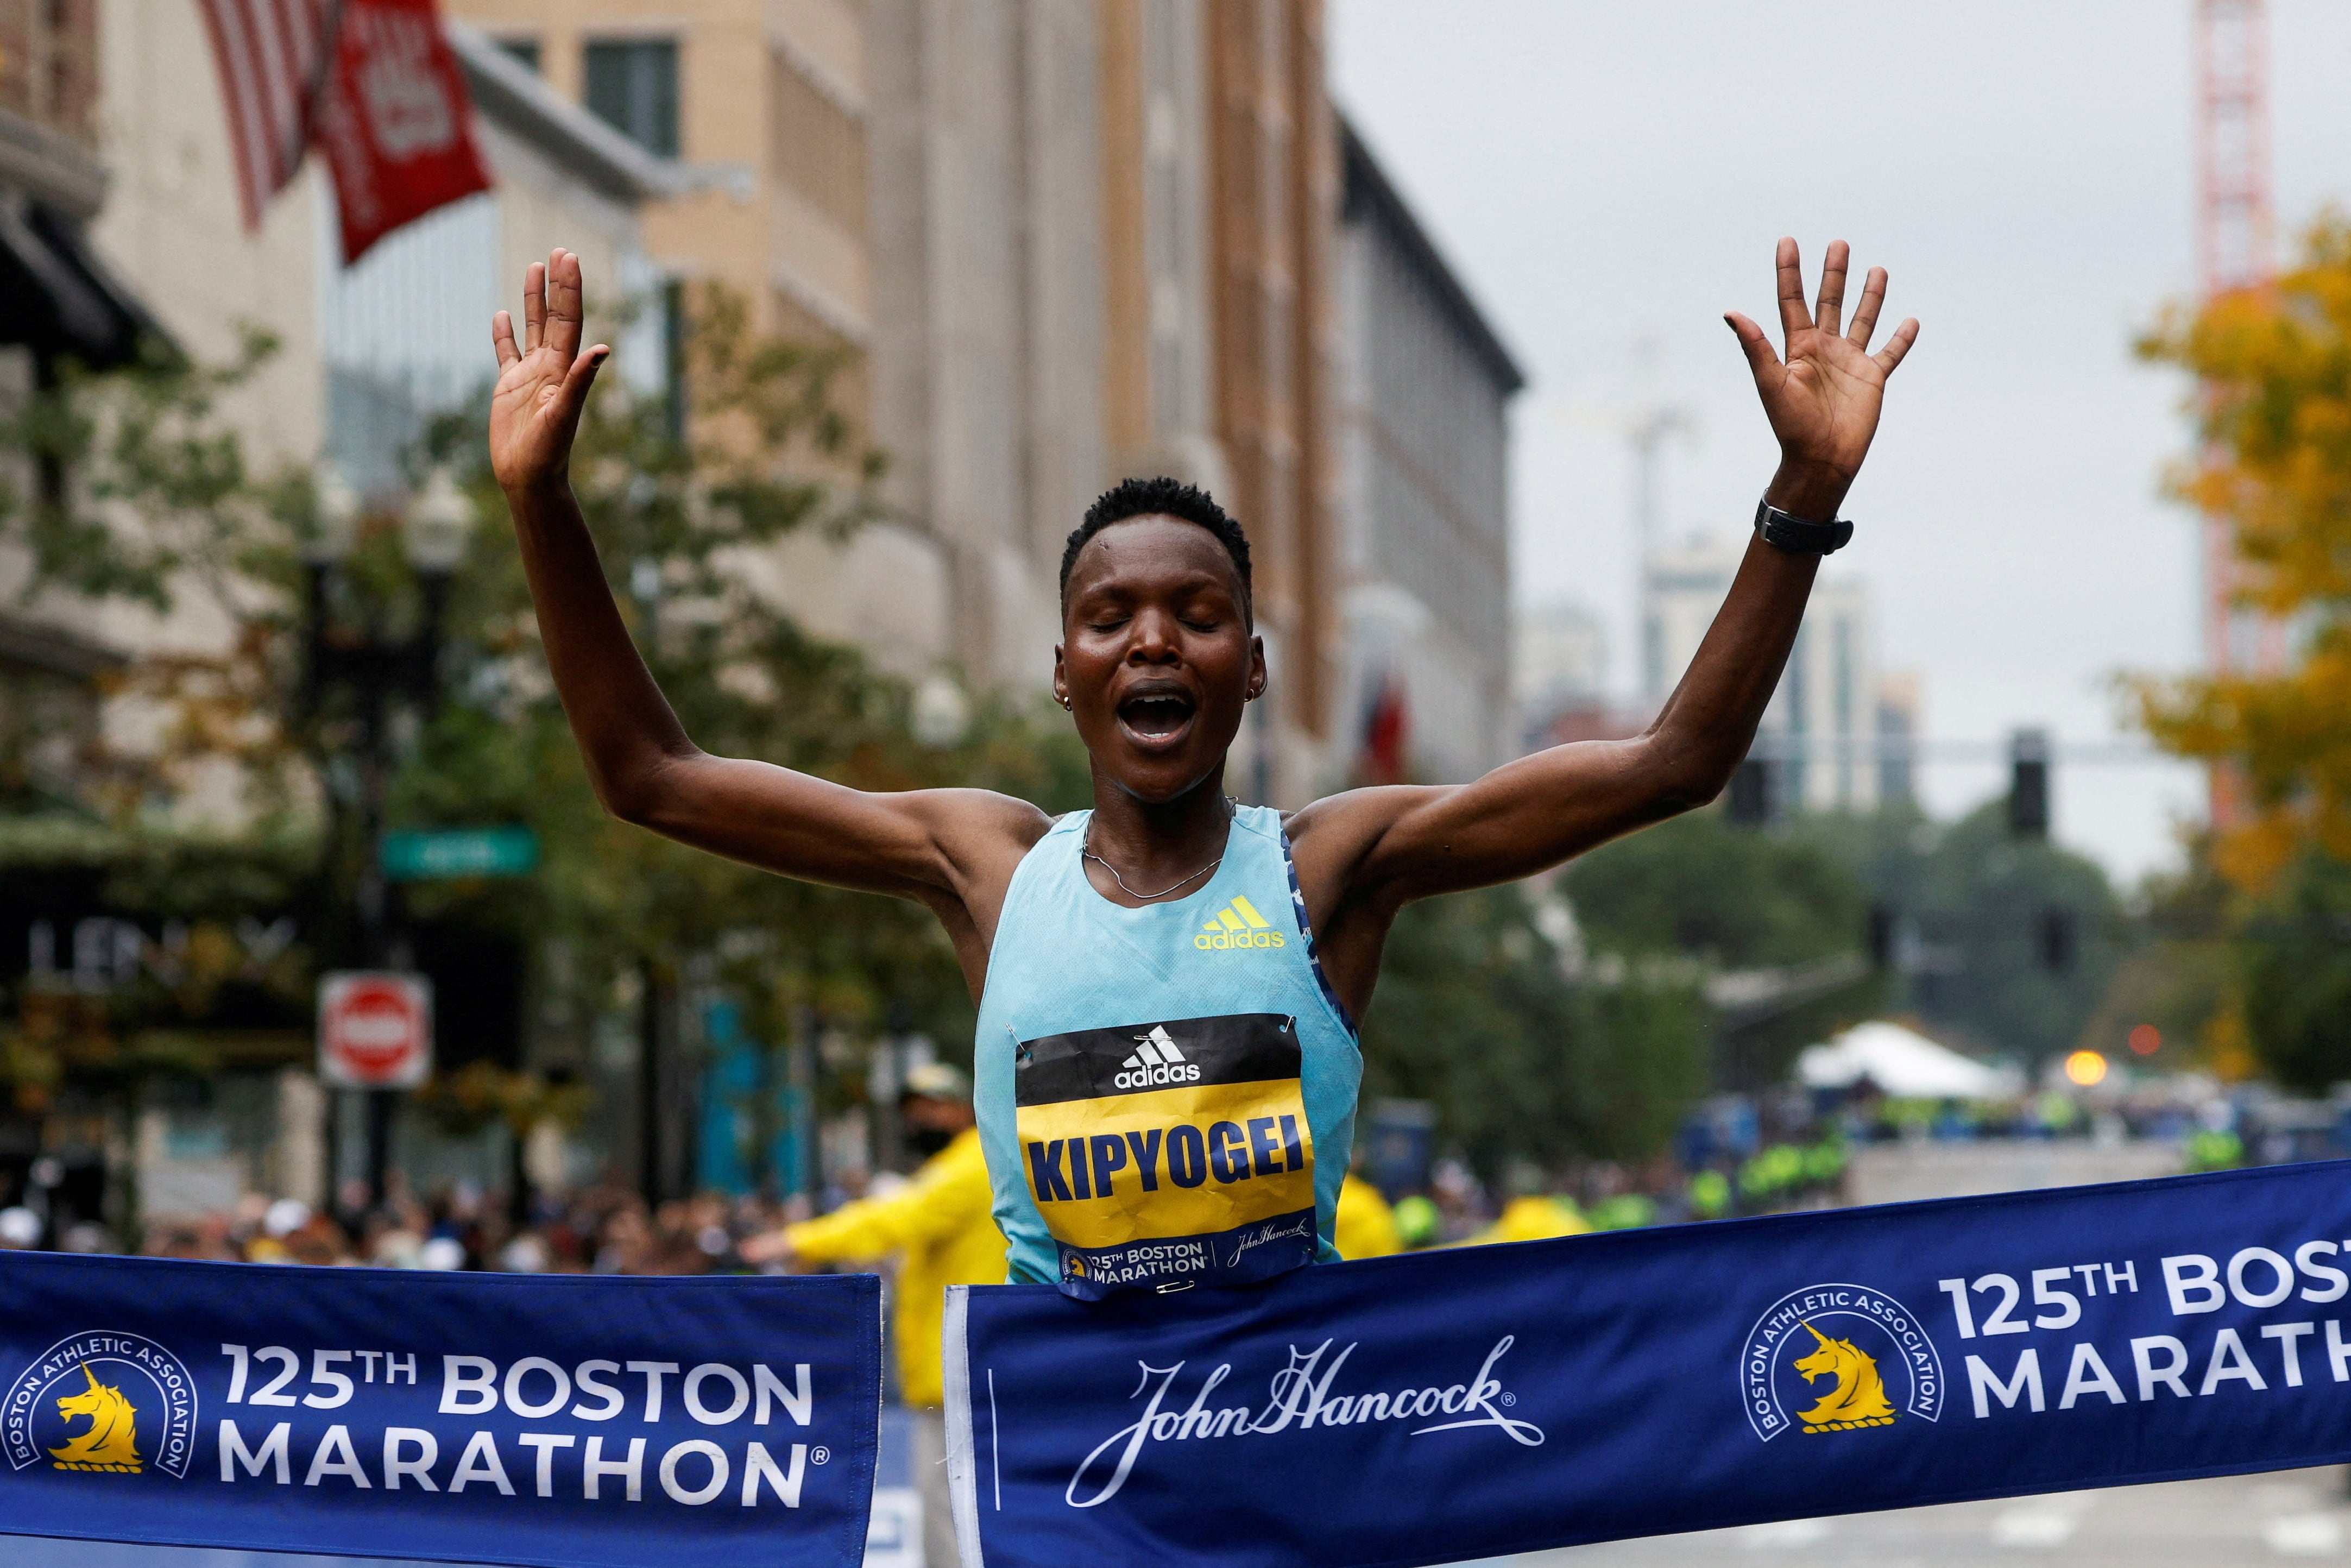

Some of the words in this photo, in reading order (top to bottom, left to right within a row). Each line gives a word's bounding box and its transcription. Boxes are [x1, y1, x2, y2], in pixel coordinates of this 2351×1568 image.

[1194, 928, 1285, 950] adidas
[1114, 1062, 1201, 1088] adidas
[1028, 1114, 1304, 1201] KIPYOGEI
[1127, 1242, 1203, 1264] BOSTON
[1227, 1232, 1259, 1267] John
[1256, 1218, 1310, 1245] Hancock
[1763, 1292, 1849, 1343] ATHLETIC
[1939, 1261, 2138, 1339] 125TH
[2161, 1240, 2351, 1315] BOS
[223, 1344, 416, 1409] 125TH
[438, 1355, 812, 1426] BOSTON
[1750, 1344, 1779, 1430] BOSTON
[1855, 1295, 1936, 1411] ASSOCIATION
[9, 1377, 42, 1459] BOSTON
[43, 1338, 133, 1378] ATHLETIC
[135, 1347, 188, 1468] ASSOCIATION
[1066, 1359, 1250, 1508] John
